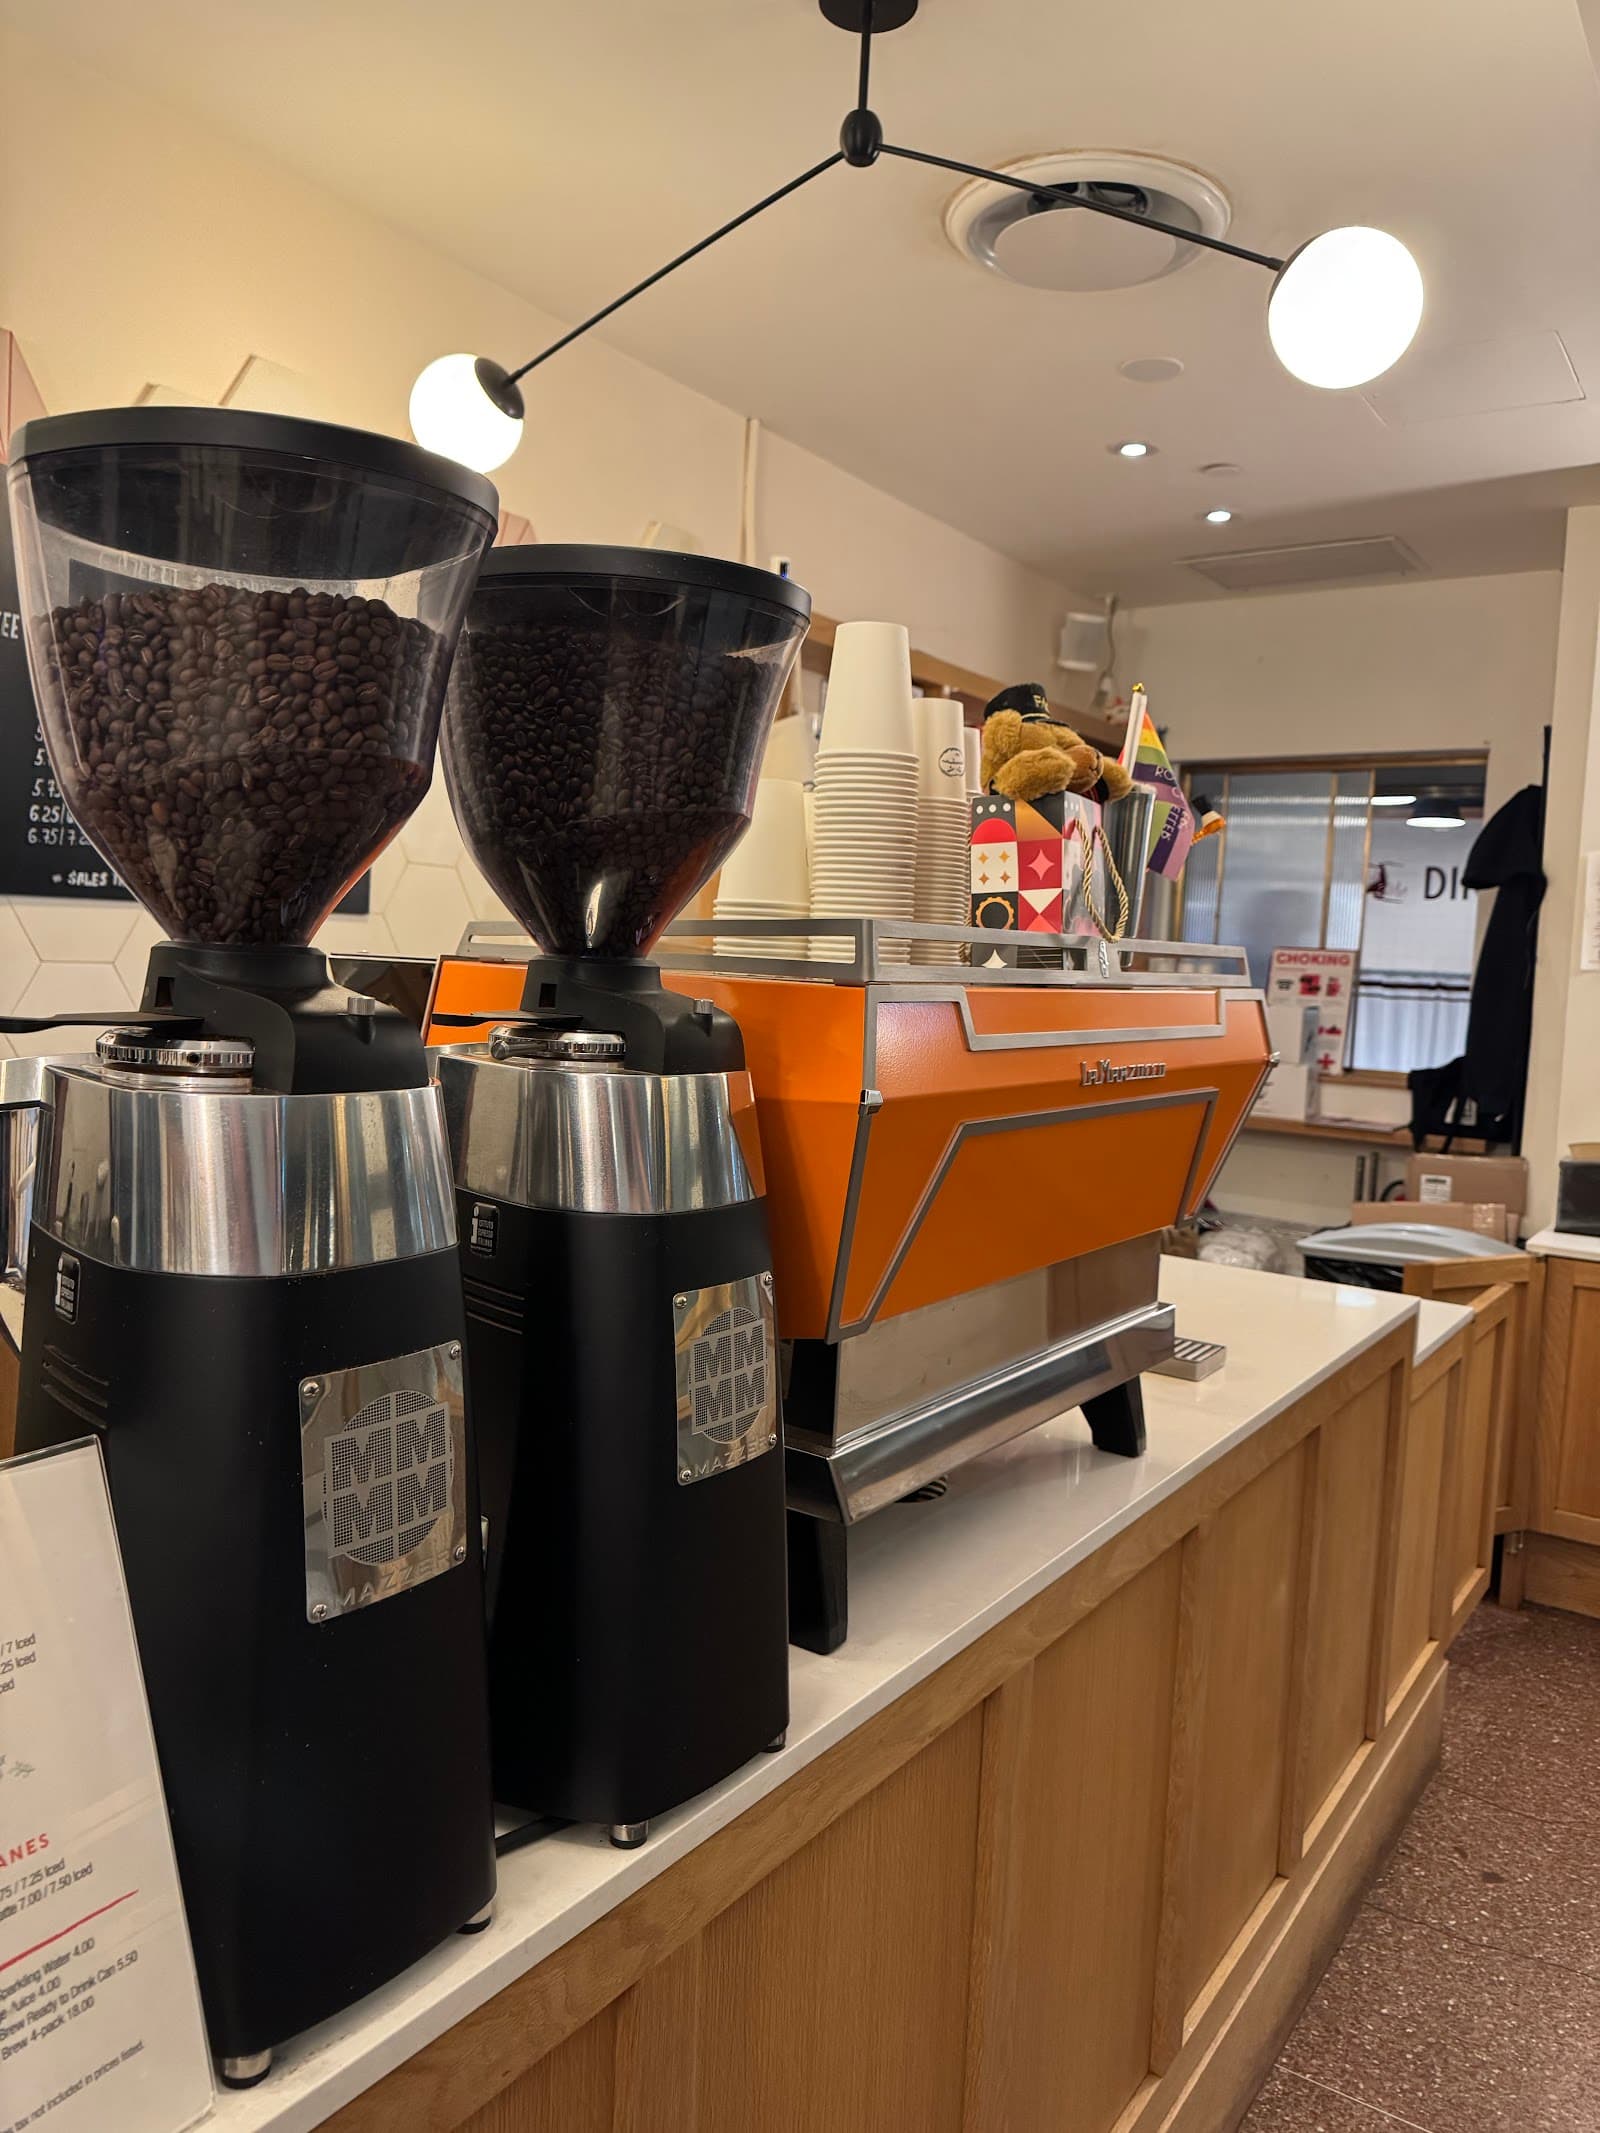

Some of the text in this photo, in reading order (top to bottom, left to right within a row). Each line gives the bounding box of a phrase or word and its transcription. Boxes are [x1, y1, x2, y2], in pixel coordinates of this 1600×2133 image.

[0, 611, 20, 639] EE
[67, 869, 108, 888] SALES
[1276, 952, 1351, 967] CHOKING
[694, 1436, 768, 1477] MAZZER
[333, 1549, 451, 1608] MAZZER
[15, 1632, 36, 1649] Iced
[15, 1650, 36, 1668] Iced
[45, 1857, 65, 1877] Iced
[73, 1862, 93, 1881] Iced
[72, 1937, 95, 1957] 4.00
[27, 2000, 57, 2024] Ready
[59, 1993, 69, 2006] to
[70, 1976, 96, 1999] Drink
[97, 1965, 116, 1983] Can
[116, 1950, 138, 1971] 5.50
[38, 1976, 61, 1997] 4.00
[1, 1995, 95, 2061] Brew 4-pack 18.00
[31, 2104, 46, 2120] not
[46, 2079, 83, 2110] included
[84, 2074, 93, 2085] in
[94, 2056, 120, 2081] prices
